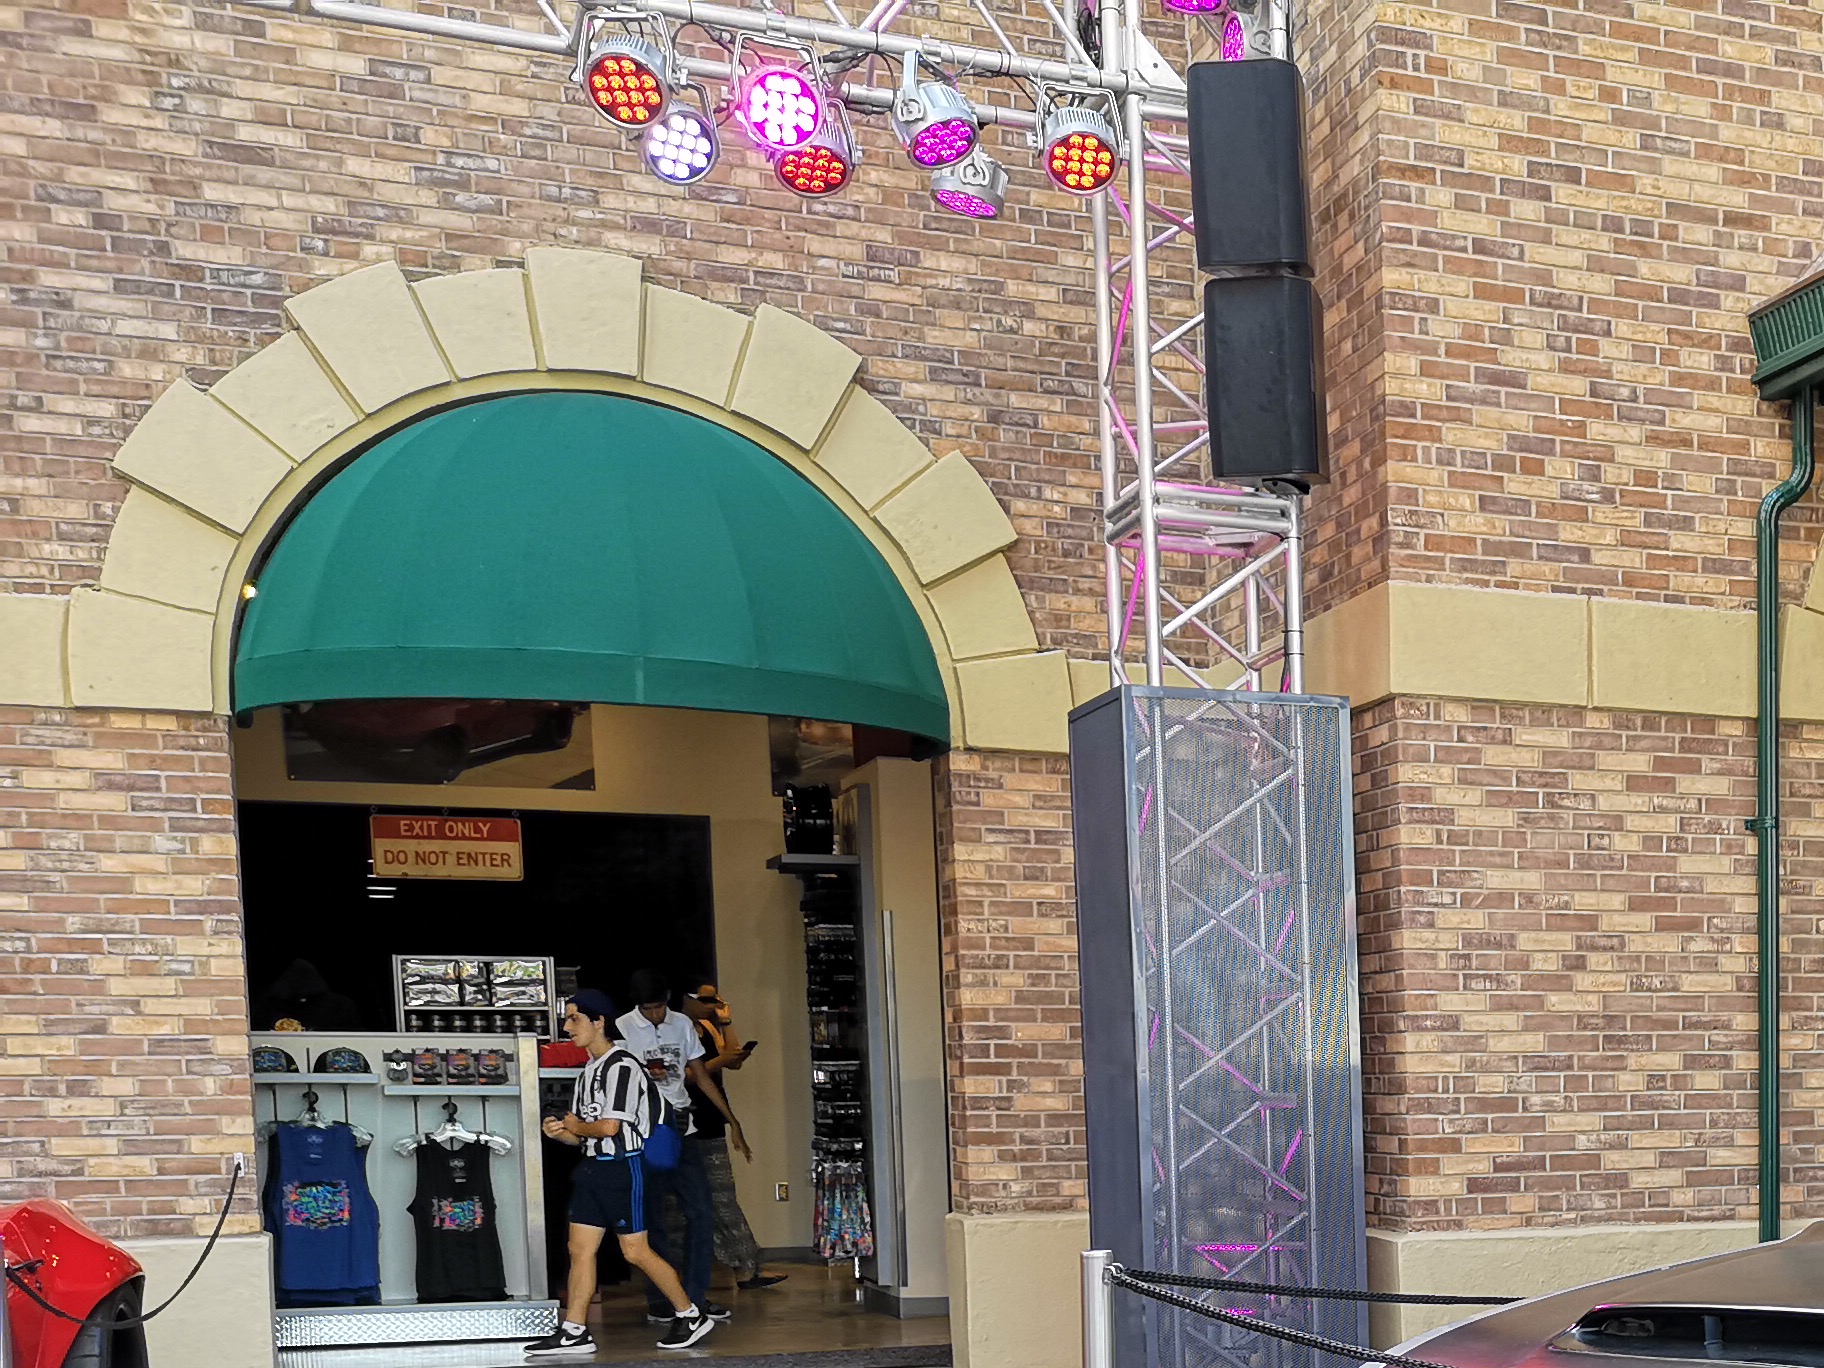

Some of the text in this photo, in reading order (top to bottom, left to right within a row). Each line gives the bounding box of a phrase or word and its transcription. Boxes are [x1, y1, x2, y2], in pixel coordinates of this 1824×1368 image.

[400, 820, 491, 838] EXIT ONLY
[384, 850, 512, 868] DO NOT ENTER
